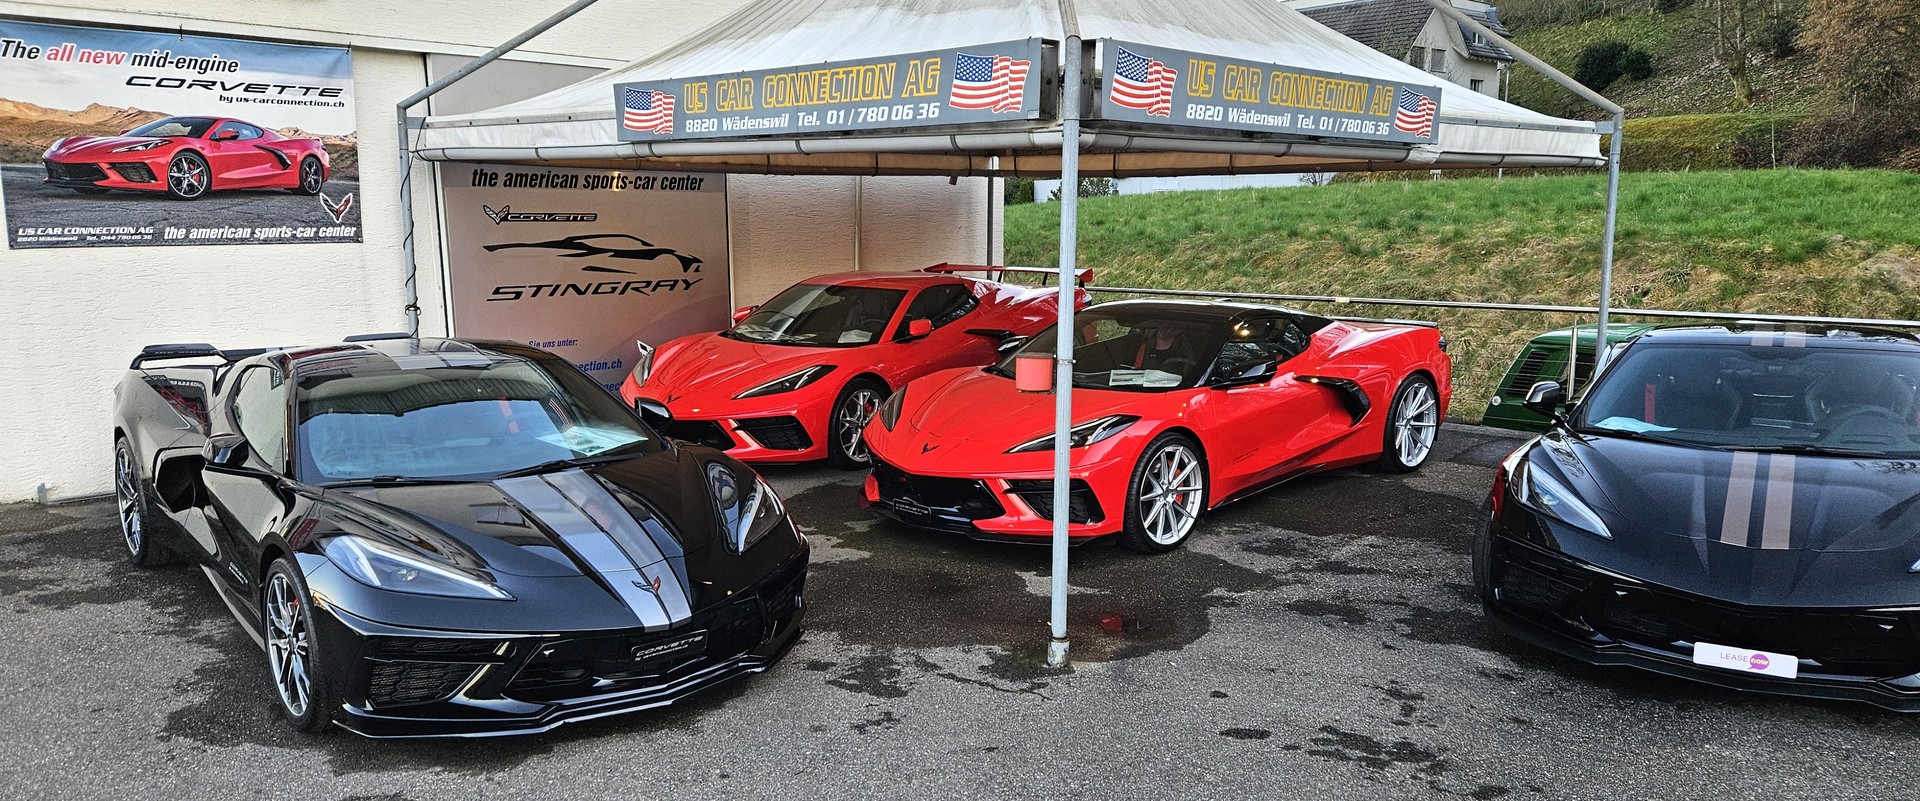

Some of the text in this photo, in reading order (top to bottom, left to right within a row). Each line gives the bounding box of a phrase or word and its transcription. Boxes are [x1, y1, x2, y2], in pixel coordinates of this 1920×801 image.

[1, 40, 239, 75] The all new mid-engine
[125, 75, 344, 98] CORVETTE
[684, 57, 940, 114] US CAR CONNECTION AG
[1187, 59, 1395, 117] US CAR CONNECTION AG
[219, 95, 345, 109] by us-carconnection.ch
[685, 118, 718, 133] 8820
[722, 113, 790, 131] Wädenswil
[797, 111, 820, 126] Tel.
[891, 104, 914, 120] 06
[917, 102, 940, 119] 36
[1186, 104, 1223, 121] 8820
[1228, 107, 1291, 127] Wädenswil
[1297, 114, 1315, 130] Tel.
[1362, 120, 1376, 134] 06
[1376, 122, 1390, 135] 36
[472, 169, 704, 191] the american sports-car center
[507, 213, 596, 221] CORVETTE
[18, 226, 154, 236] US CAR CONNECTION AG
[164, 226, 356, 240] the american sports-car center
[486, 278, 704, 301] STINGRAY
[543, 340, 556, 348] uns
[557, 339, 578, 347] unter:
[636, 635, 704, 657] CORVETTE
[1720, 653, 1768, 666] LEASE now
